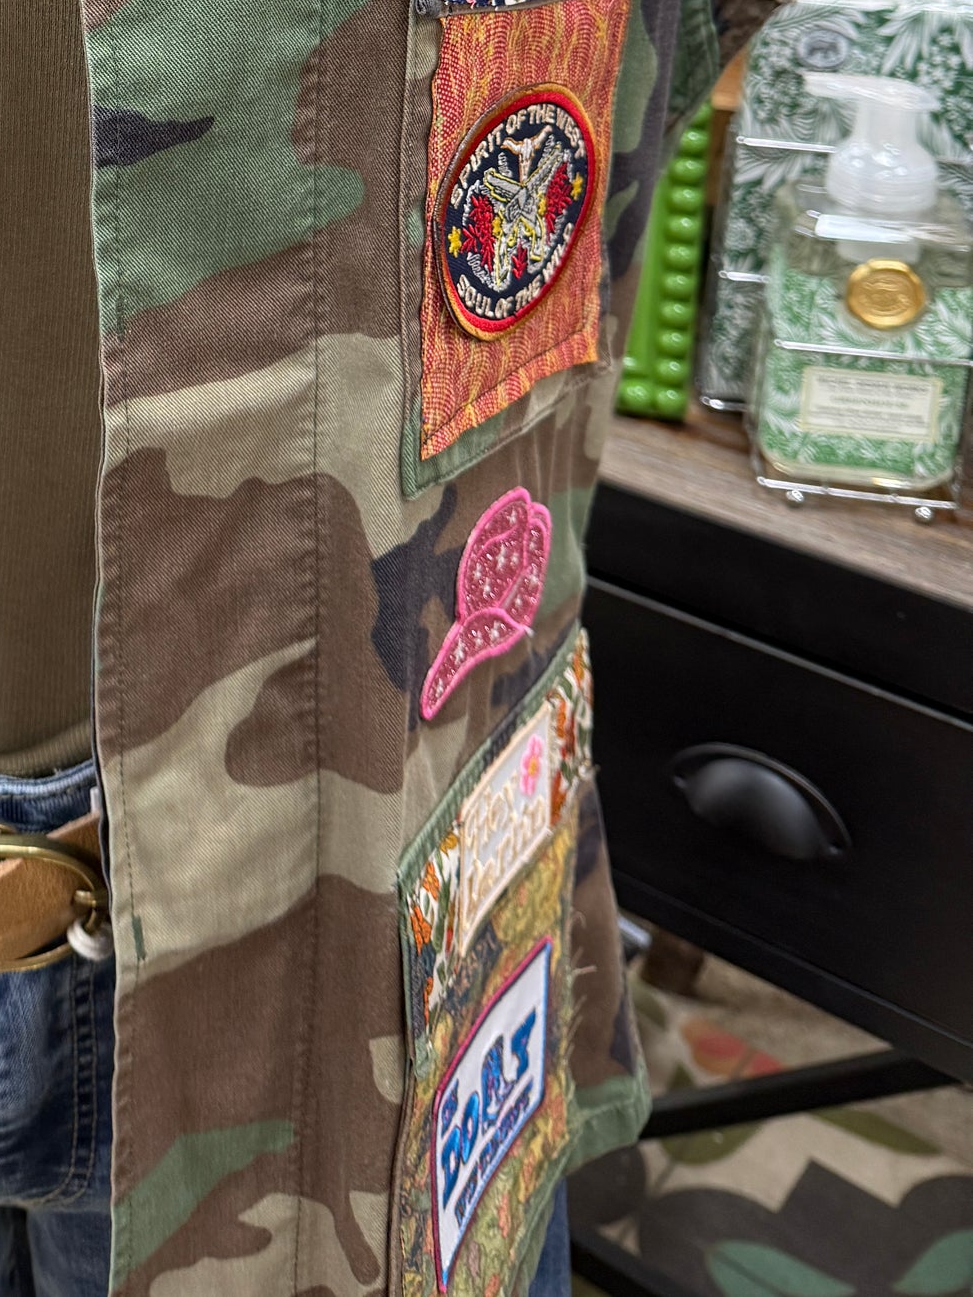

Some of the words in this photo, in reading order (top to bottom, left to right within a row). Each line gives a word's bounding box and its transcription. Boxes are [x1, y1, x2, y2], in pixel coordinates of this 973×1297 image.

[450, 123, 504, 210] SPIRIT
[505, 109, 527, 135] OF
[527, 103, 556, 125] THE
[556, 107, 585, 159] WEST
[457, 274, 494, 318] SOUL
[495, 296, 515, 319] OF
[515, 275, 542, 311] THE
